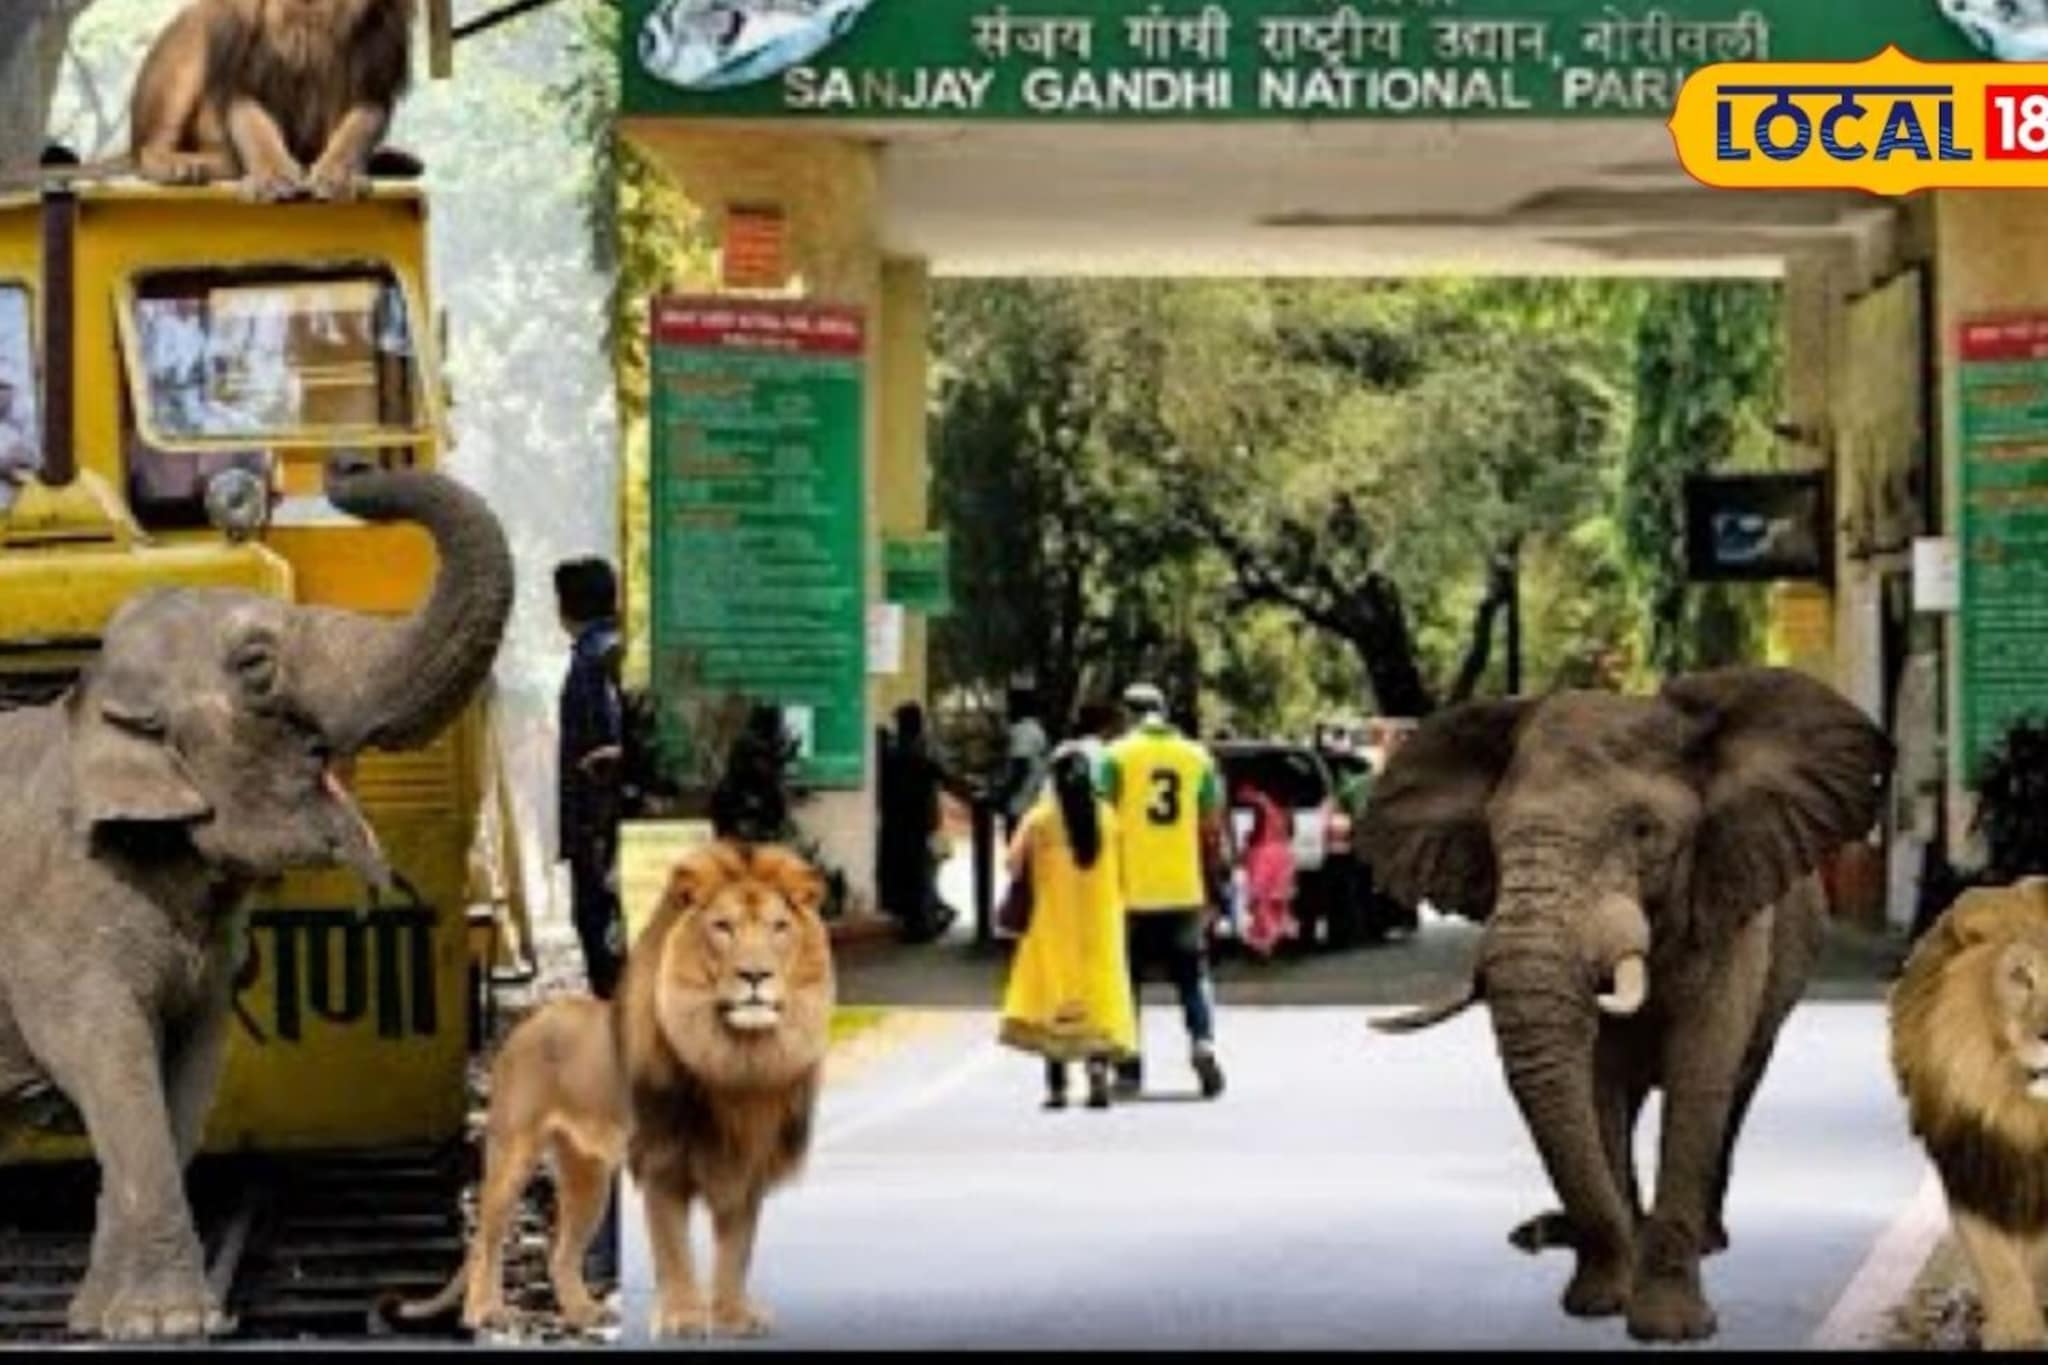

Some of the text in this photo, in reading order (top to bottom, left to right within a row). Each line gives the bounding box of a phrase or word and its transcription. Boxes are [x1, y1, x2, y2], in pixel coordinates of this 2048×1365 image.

[784, 67, 995, 109] SANJAY
[1022, 67, 1232, 109] GANDHI
[1258, 67, 1532, 109] NATIONAL
[1146, 768, 1181, 826] 3
